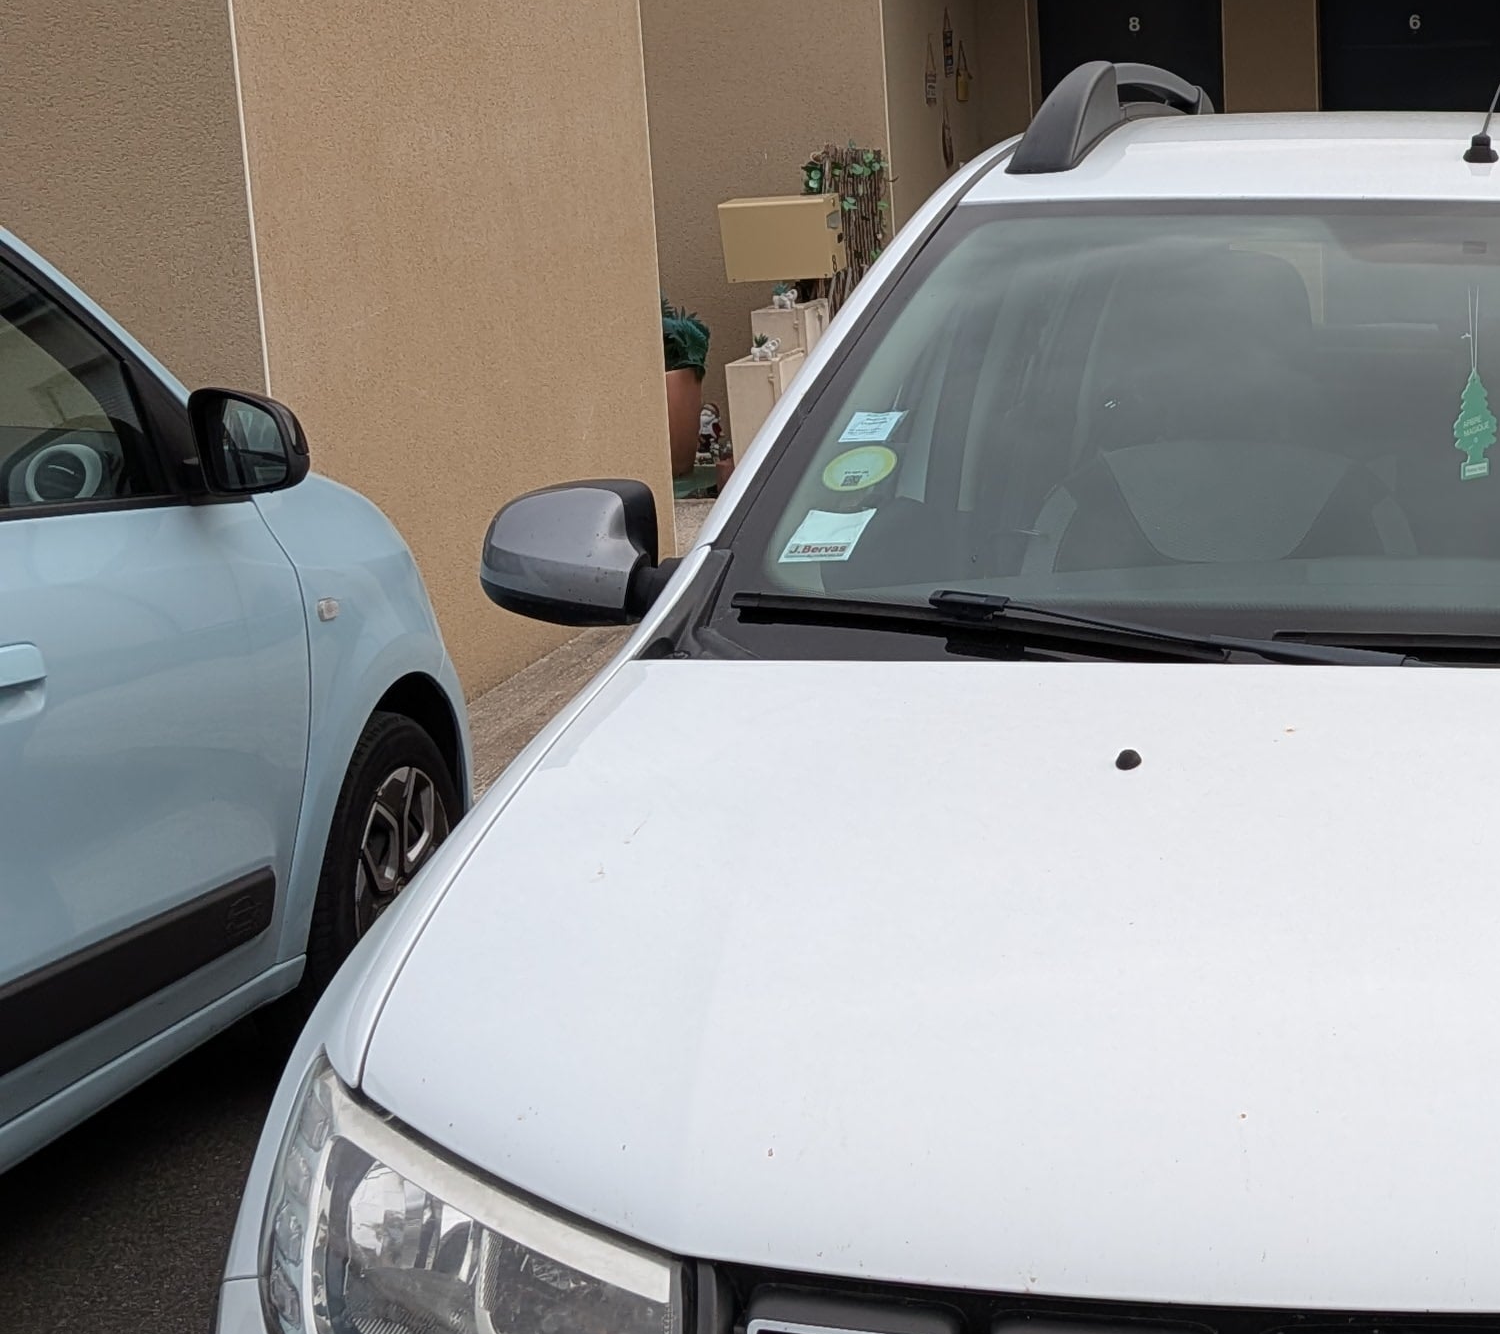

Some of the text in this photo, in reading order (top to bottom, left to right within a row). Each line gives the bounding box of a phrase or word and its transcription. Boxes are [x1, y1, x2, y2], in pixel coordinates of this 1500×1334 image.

[1129, 16, 1141, 31] 8
[1409, 14, 1421, 29] 6
[831, 254, 838, 272] 8
